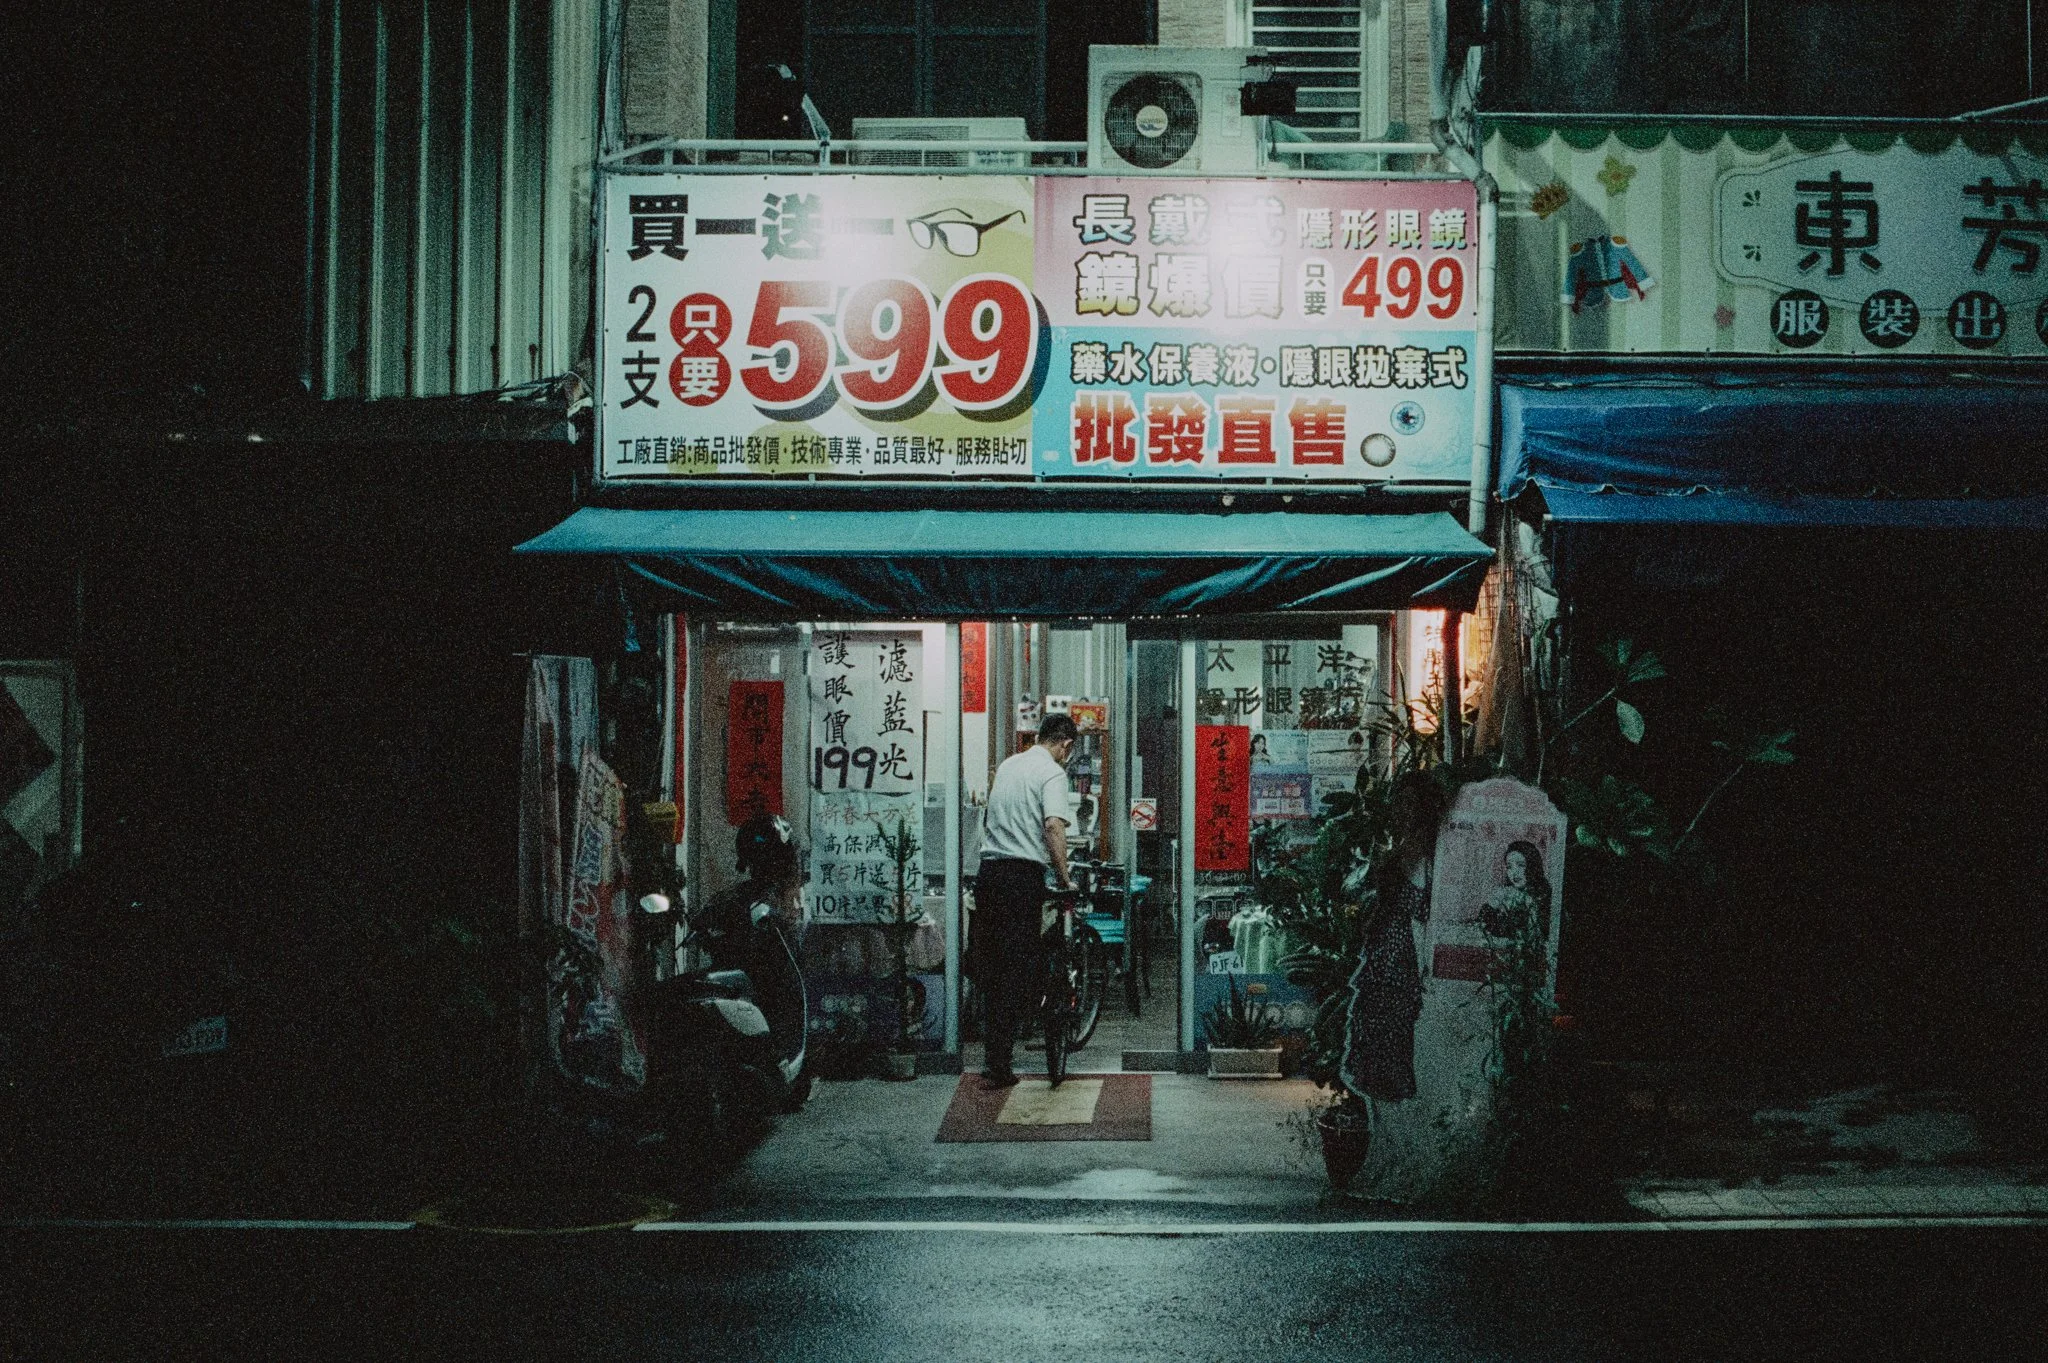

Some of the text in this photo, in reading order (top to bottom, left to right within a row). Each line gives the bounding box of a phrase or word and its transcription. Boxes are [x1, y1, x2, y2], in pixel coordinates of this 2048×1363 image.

[626, 192, 894, 262] 買一送一
[1297, 207, 1468, 250] 隱形眼鏡
[1074, 251, 1284, 320] 鏡爆價
[1302, 255, 1465, 320] 只要 499
[1774, 292, 2048, 346] 服裝出
[676, 300, 722, 400] 只要
[738, 275, 1035, 406] 599
[1073, 392, 1348, 466] 批發直售
[819, 632, 855, 746] 護眼價
[1206, 643, 1344, 674] 太平洋
[877, 638, 914, 781] 濾藍光
[815, 745, 878, 790] 199
